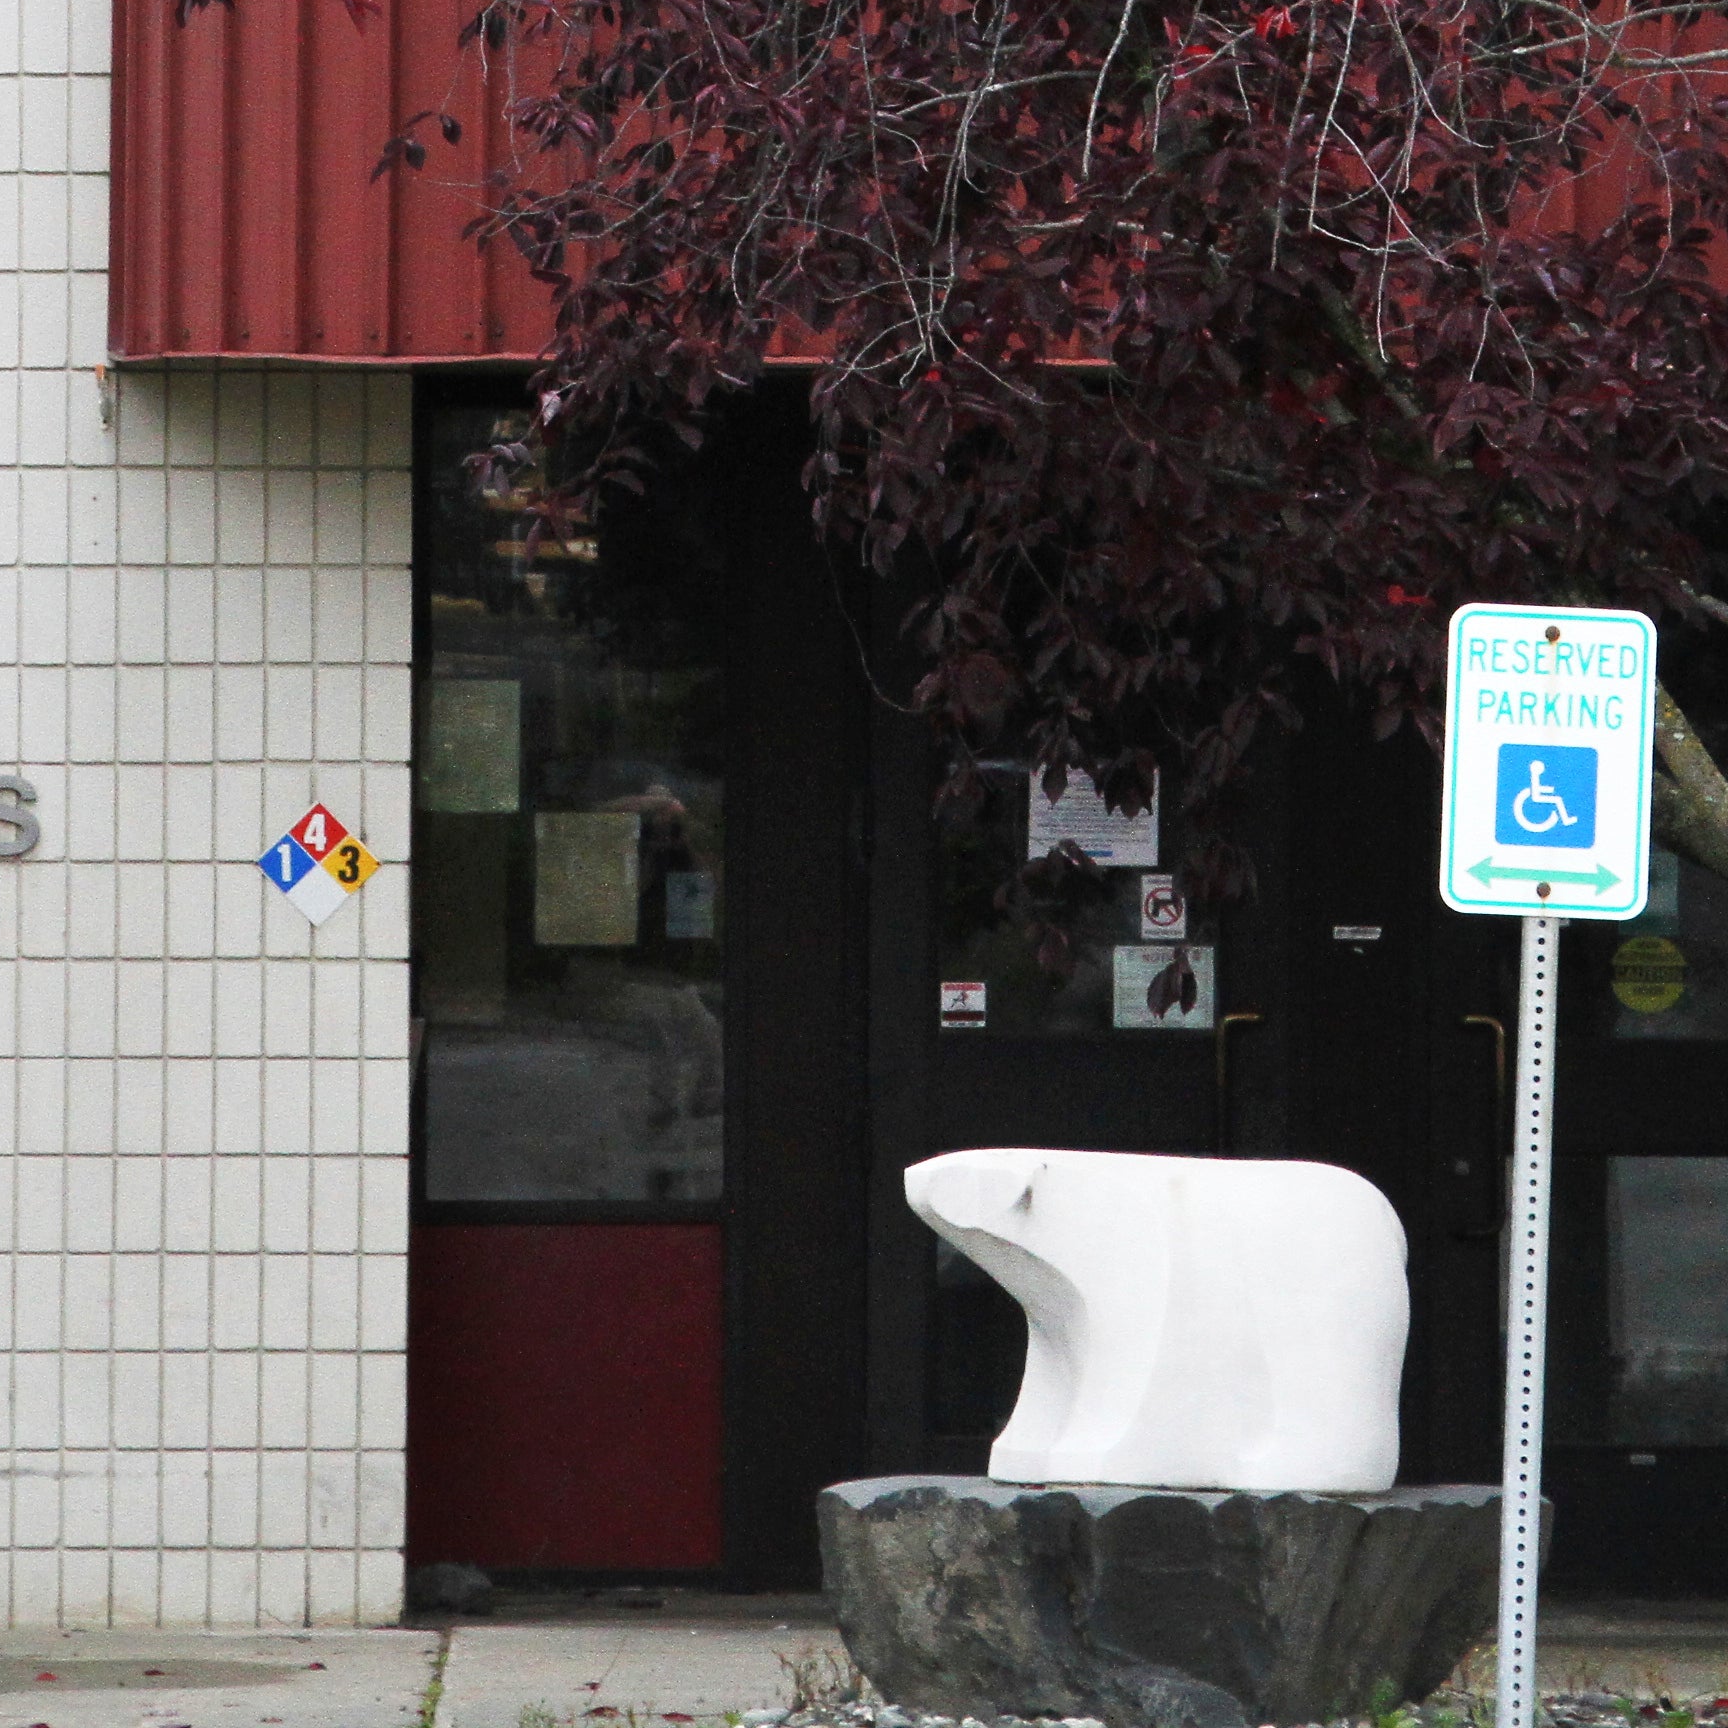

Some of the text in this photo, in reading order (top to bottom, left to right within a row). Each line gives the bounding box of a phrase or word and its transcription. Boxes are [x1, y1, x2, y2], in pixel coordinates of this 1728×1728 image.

[1468, 638, 1638, 679] RESERVED
[1477, 689, 1624, 730] PARKING
[303, 813, 327, 851] 4
[277, 844, 292, 882] 1
[338, 845, 360, 883] 3
